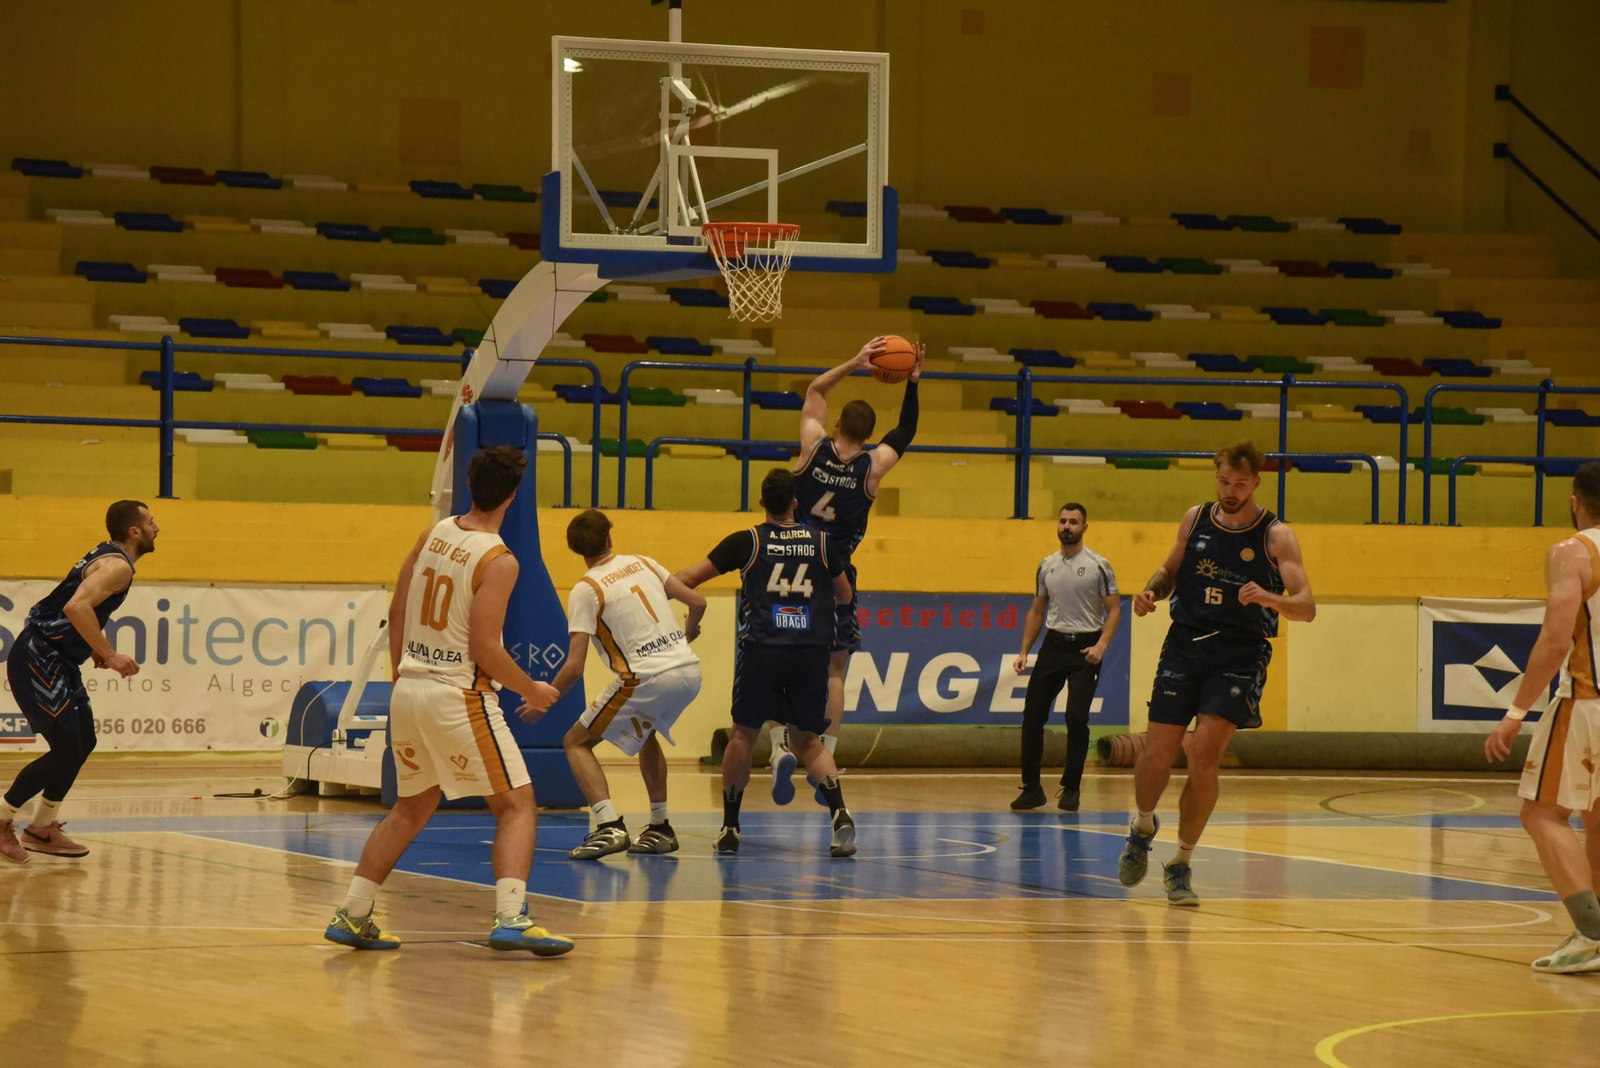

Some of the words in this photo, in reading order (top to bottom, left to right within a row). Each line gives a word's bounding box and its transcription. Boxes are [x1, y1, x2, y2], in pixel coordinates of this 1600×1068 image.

[828, 475, 857, 489] STROG
[810, 491, 836, 522] 4
[769, 530, 779, 539] A.
[780, 529, 812, 540] GARCÍA
[428, 537, 452, 556] EDU
[450, 547, 472, 566] GEA
[786, 545, 815, 557] STROG
[600, 561, 644, 588] FERNÁNDEZ
[766, 562, 814, 598] 44
[420, 566, 454, 632] 10
[630, 584, 660, 624] 1
[1204, 586, 1223, 605] 15
[775, 615, 807, 629] UBAGO
[856, 602, 1029, 630] ectricid
[0, 594, 356, 666] mitecni
[432, 648, 463, 664] OLEA
[207, 673, 303, 697] Algeci
[843, 652, 1104, 714] NGE
[0, 718, 29, 732] KF
[94, 718, 125, 734] 956
[131, 718, 166, 734] 020
[172, 718, 206, 734] 666
